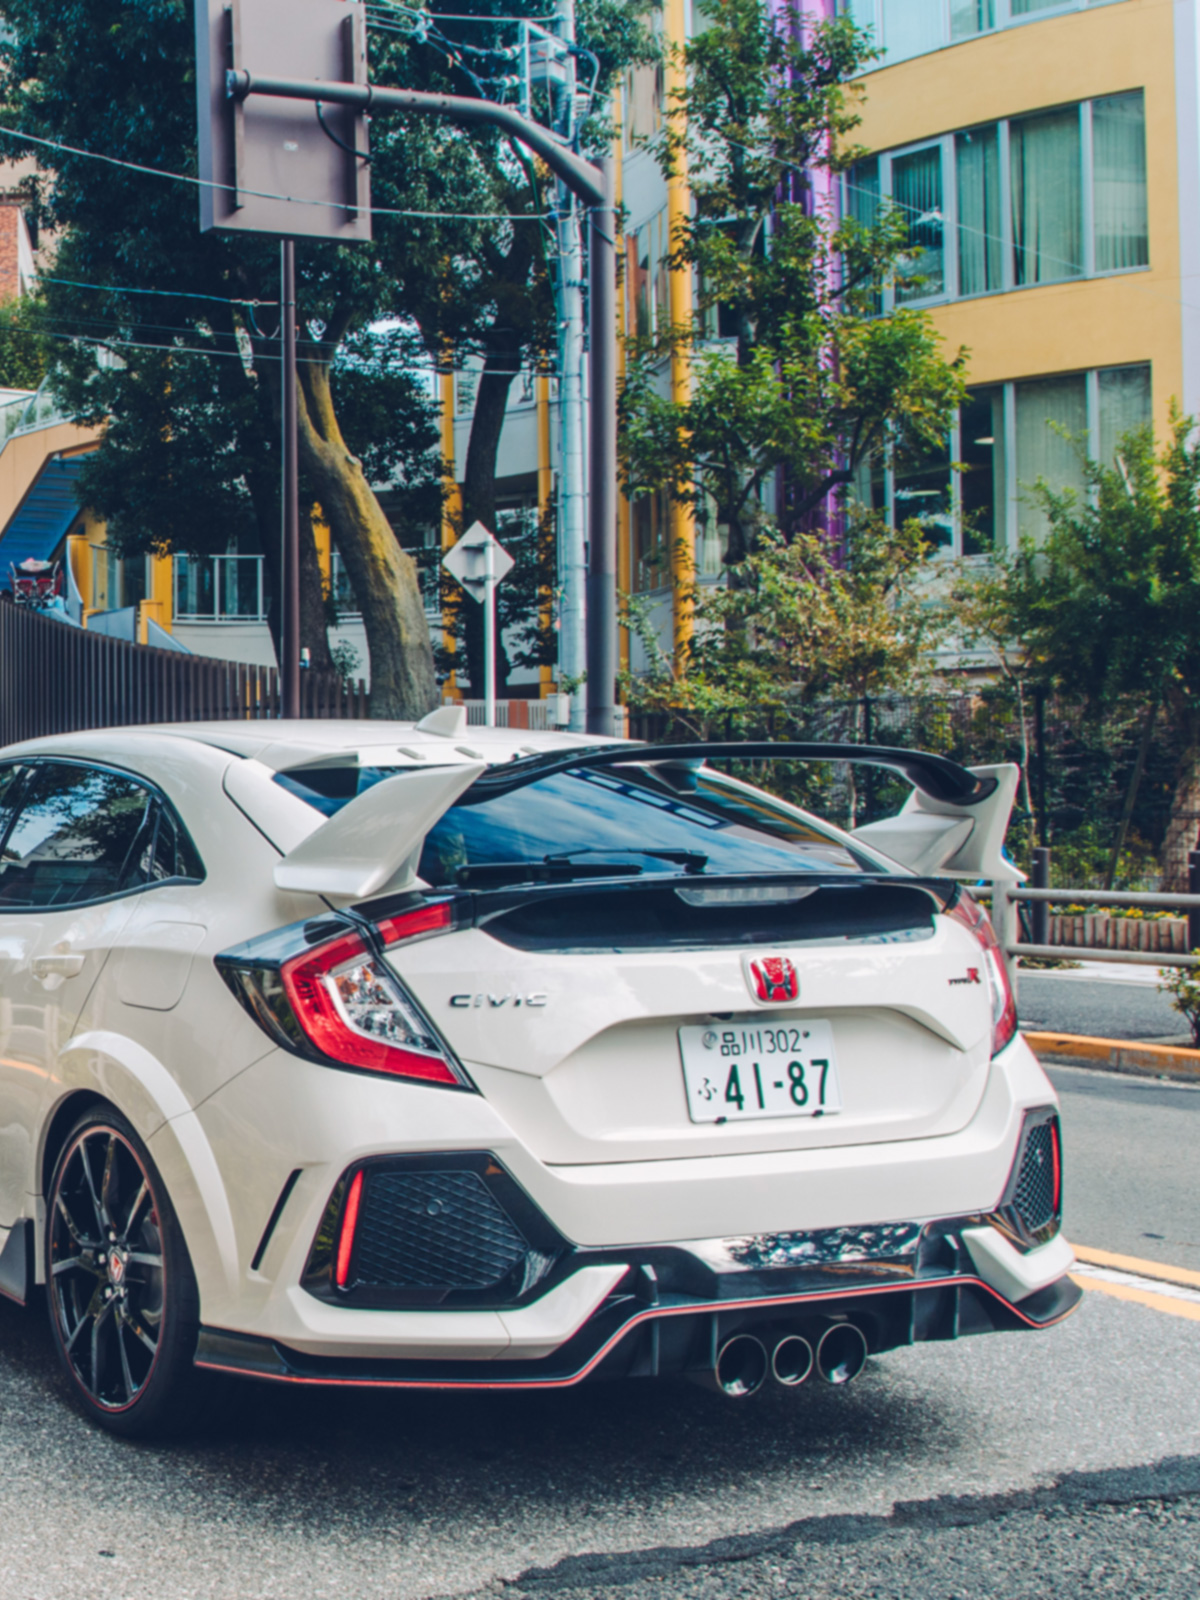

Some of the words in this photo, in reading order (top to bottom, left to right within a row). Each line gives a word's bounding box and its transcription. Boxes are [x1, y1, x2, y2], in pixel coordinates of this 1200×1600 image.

[449, 993, 547, 1008] CIVIC
[698, 1077, 717, 1101] ふ
[725, 1059, 828, 1110] 41-87
